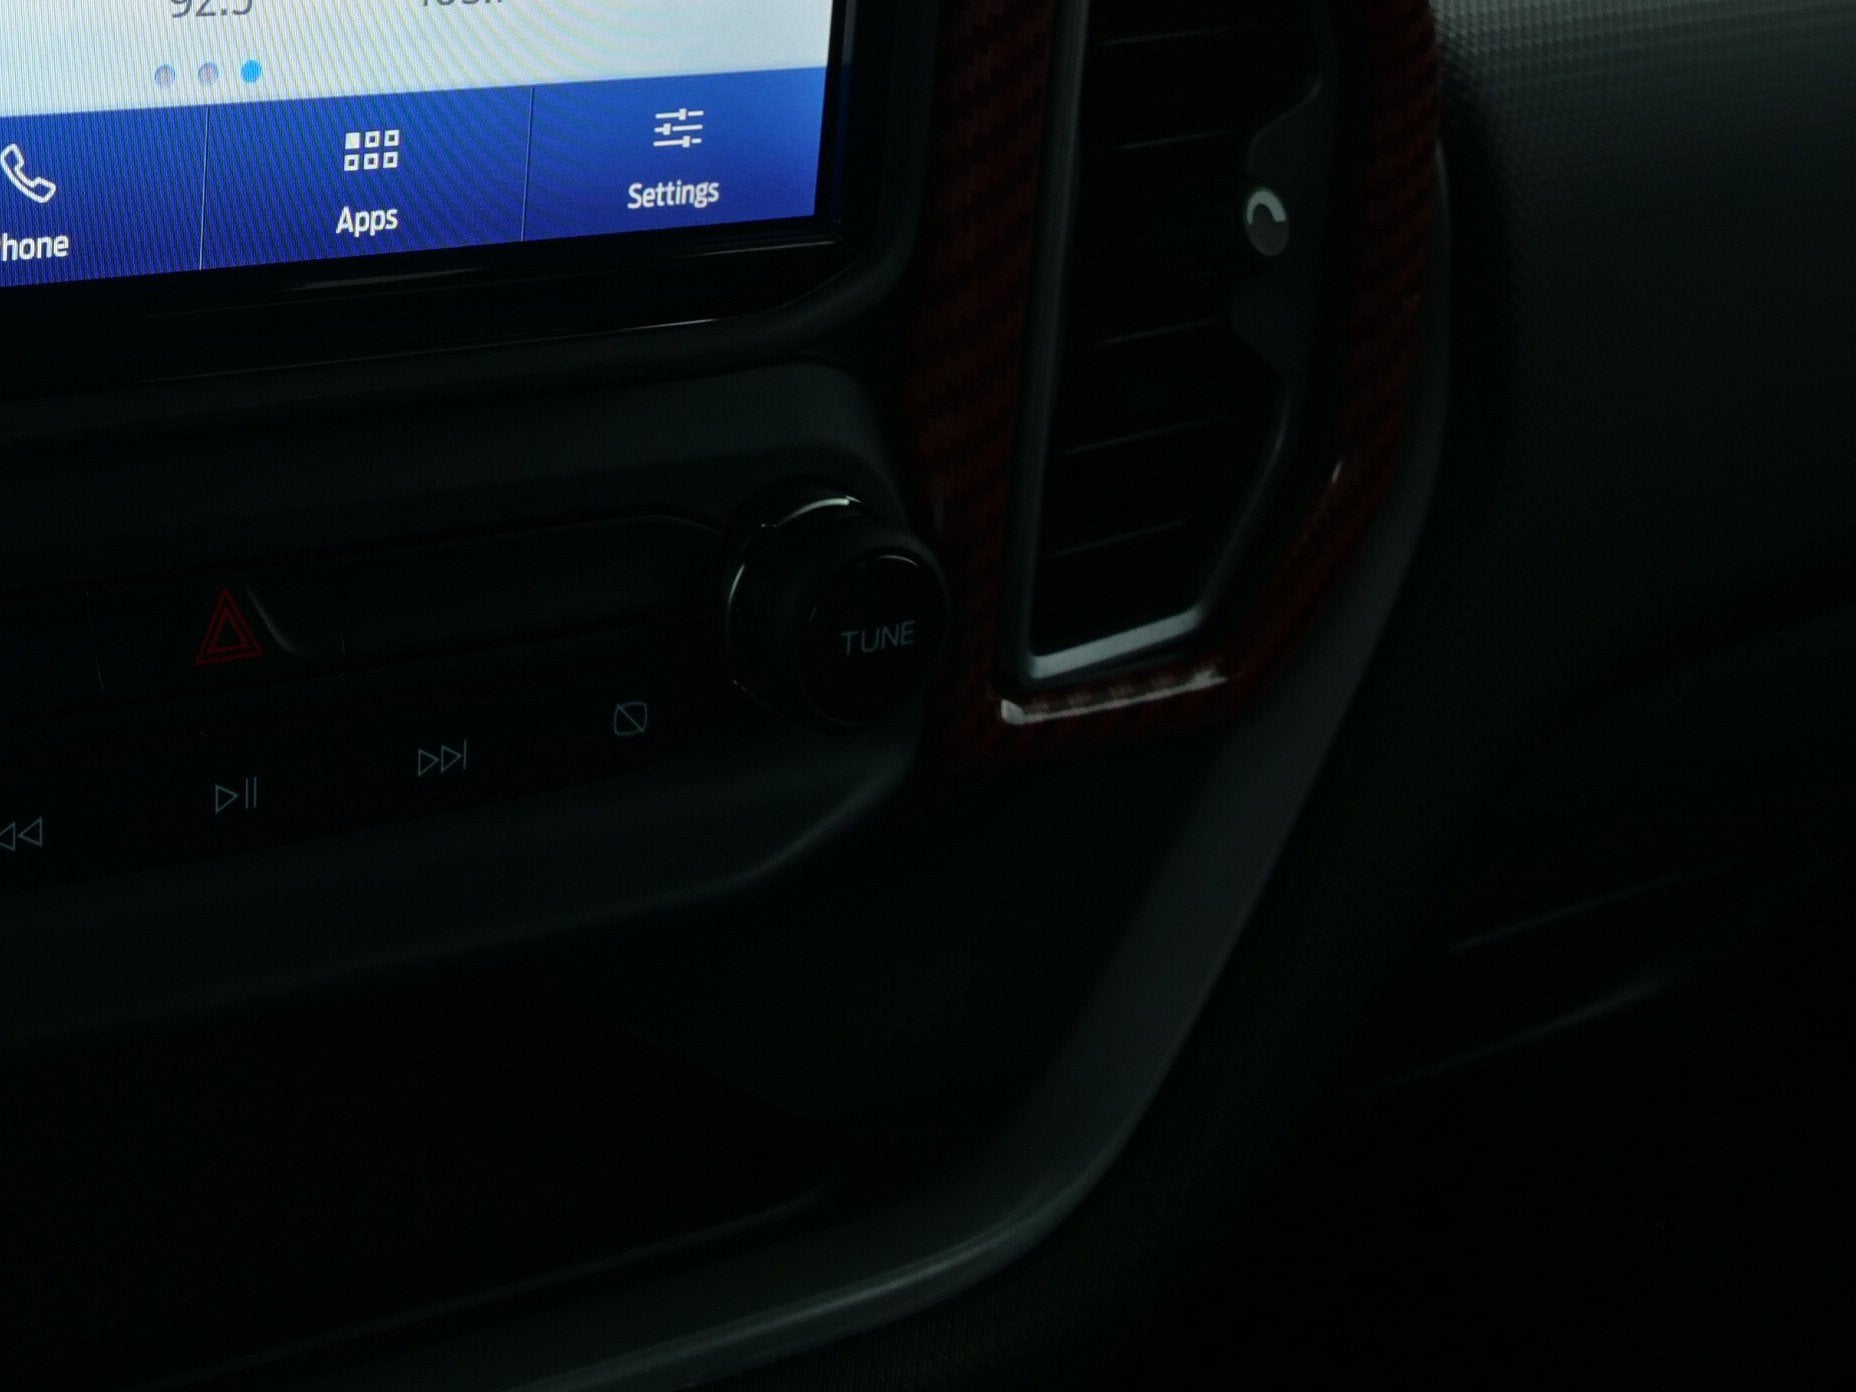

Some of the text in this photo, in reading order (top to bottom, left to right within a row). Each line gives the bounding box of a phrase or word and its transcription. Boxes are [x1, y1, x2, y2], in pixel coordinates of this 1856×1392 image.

[627, 177, 721, 212] Settings
[335, 204, 399, 239] Apps
[840, 620, 917, 656] TUNE
